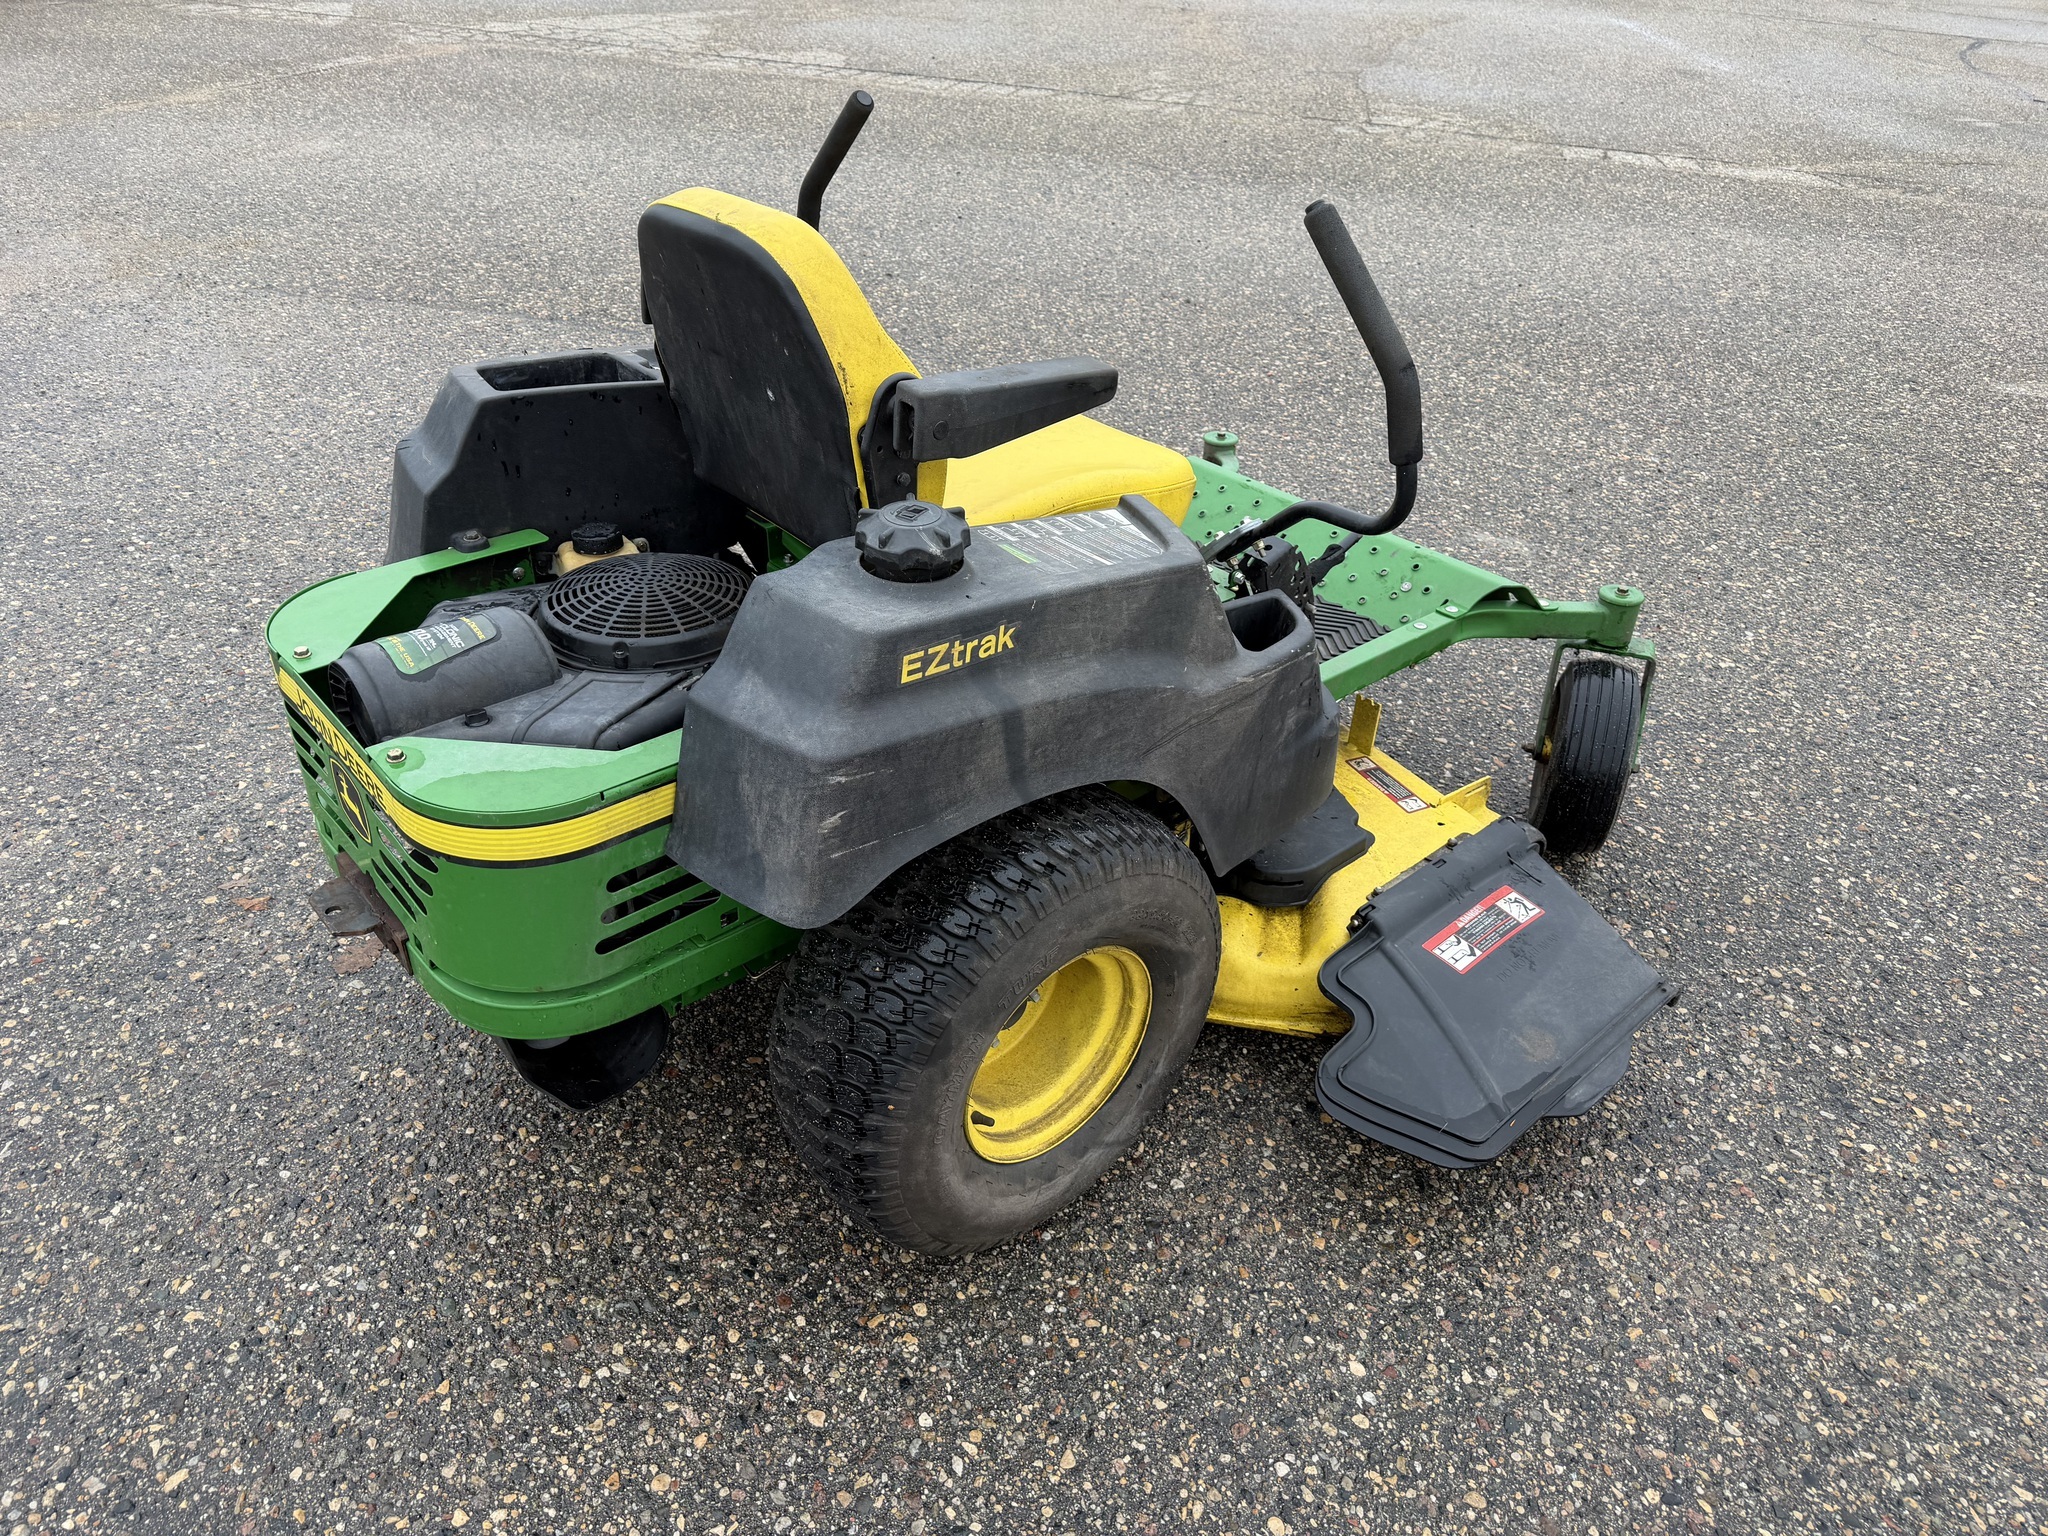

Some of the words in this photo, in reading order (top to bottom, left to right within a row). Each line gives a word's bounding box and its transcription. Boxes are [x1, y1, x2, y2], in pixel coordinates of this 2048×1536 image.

[901, 625, 1017, 684] EZtrak
[296, 688, 333, 746] JOHN
[331, 730, 387, 810] DEERE
[1461, 904, 1486, 927] DANGER
[998, 945, 1060, 1011] TURF
